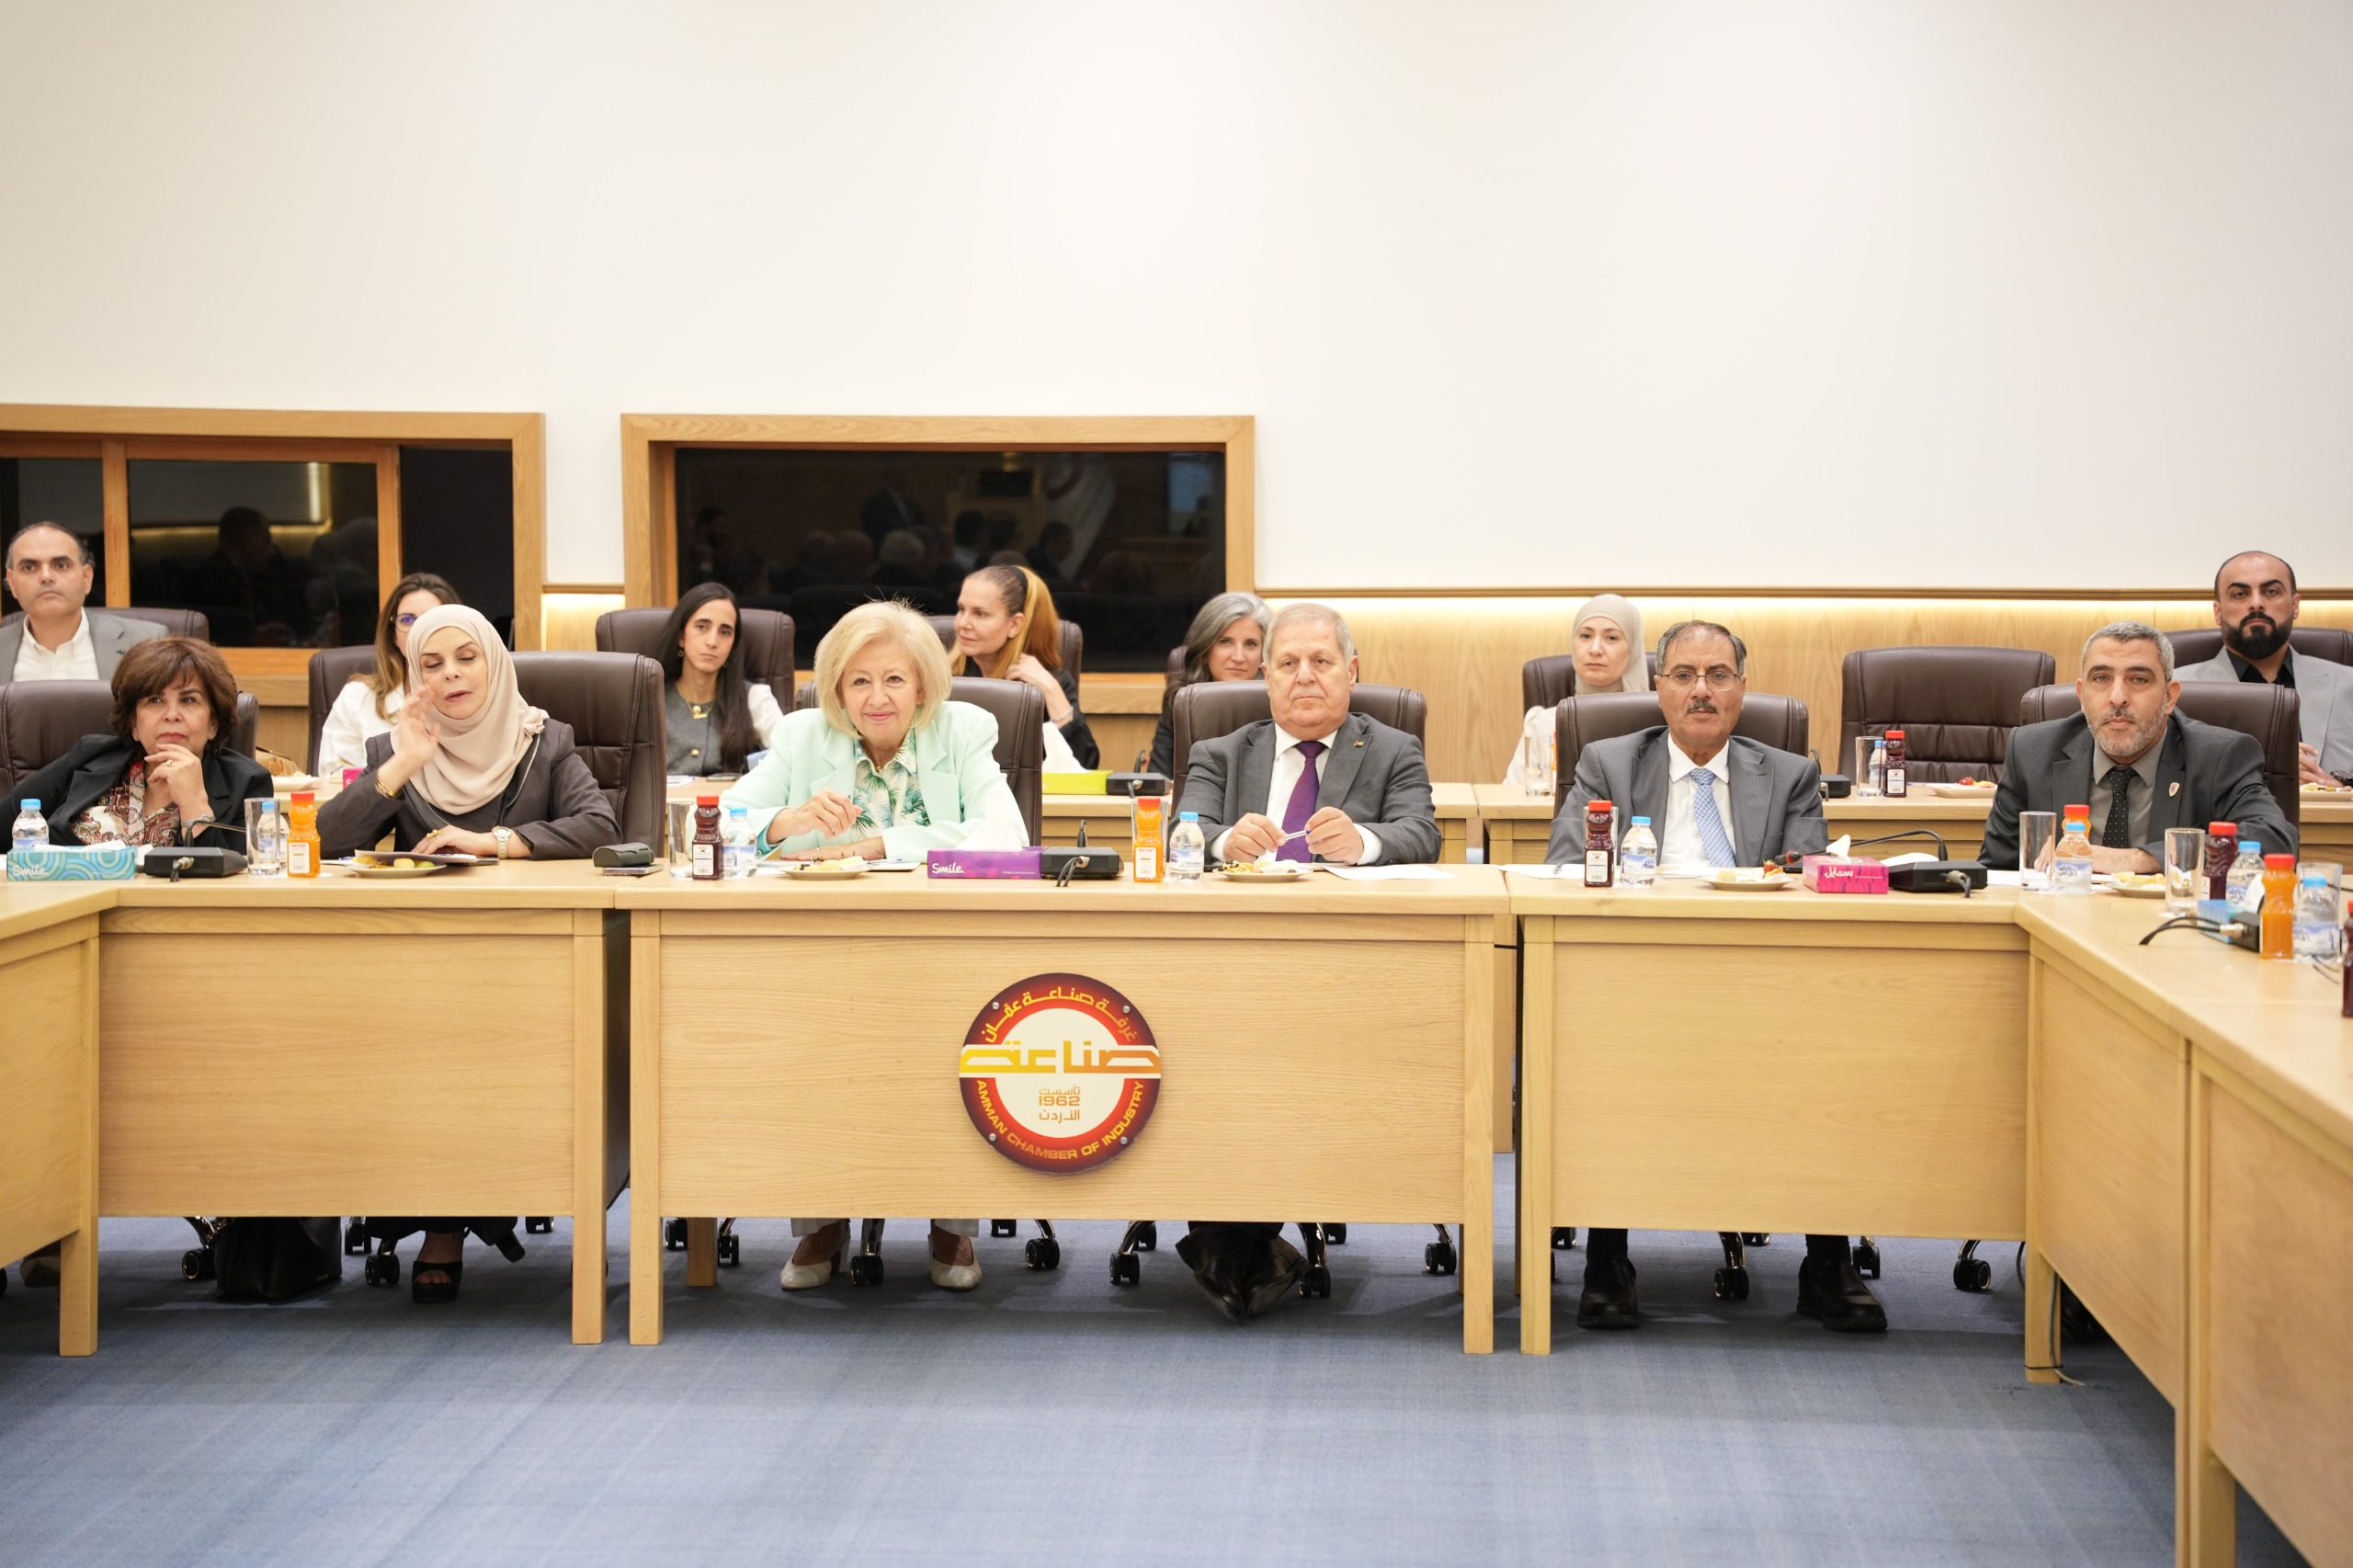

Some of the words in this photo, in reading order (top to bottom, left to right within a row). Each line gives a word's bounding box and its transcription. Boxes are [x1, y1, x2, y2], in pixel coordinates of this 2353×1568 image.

[1824, 867, 1854, 879] سمايل
[1022, 986, 1095, 1006] صناعة
[1095, 998, 1138, 1041] غرفة
[1039, 1096, 1080, 1106] 1962
[977, 1079, 1007, 1134] AMMAN
[1006, 1132, 1078, 1160] CHAMBER
[1081, 1142, 1100, 1156] OF
[1102, 1081, 1143, 1146] INDUSTRY
